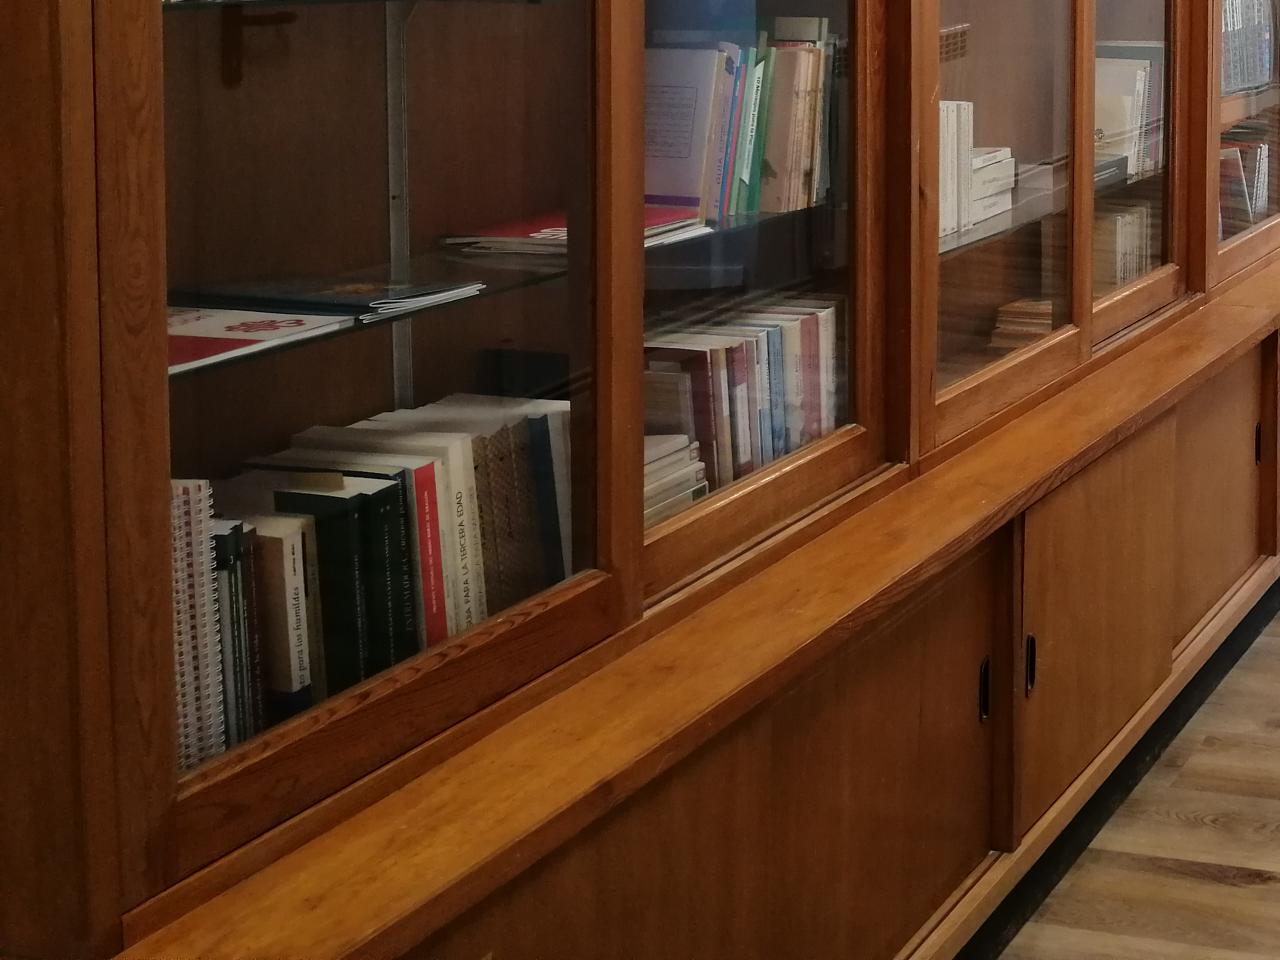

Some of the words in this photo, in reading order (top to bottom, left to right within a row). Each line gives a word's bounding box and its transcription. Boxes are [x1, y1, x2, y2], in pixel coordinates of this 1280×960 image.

[455, 490, 464, 518] EDAD
[457, 520, 468, 561] TERCERA
[461, 562, 469, 576] LA
[462, 579, 471, 603] PARA
[292, 586, 302, 631] humildes
[295, 633, 304, 647] los
[297, 649, 307, 671] para
